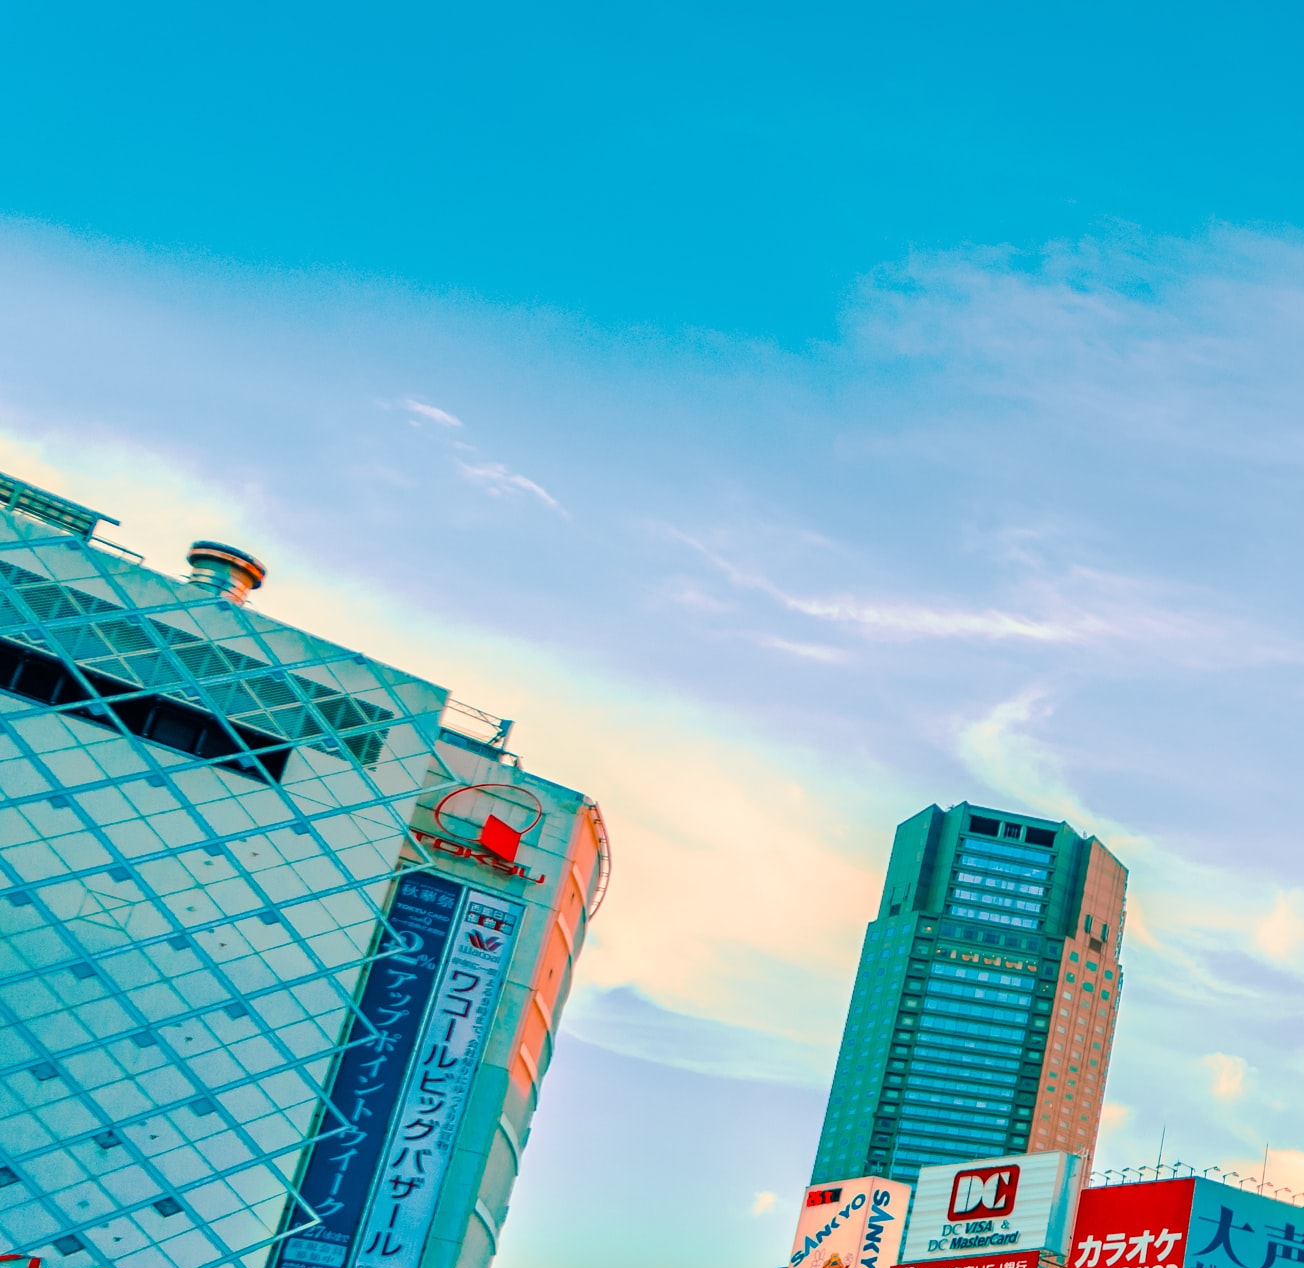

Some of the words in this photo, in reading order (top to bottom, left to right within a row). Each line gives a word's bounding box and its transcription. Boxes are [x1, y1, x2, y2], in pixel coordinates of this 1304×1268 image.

[410, 828, 546, 884] TOKYU
[366, 970, 480, 1256] ワコールビッグバザール
[953, 1171, 1011, 1214] DC
[791, 1194, 866, 1268] SANKYO
[928, 1239, 949, 1252] DC
[950, 1231, 1019, 1249] MasterCard
[942, 1223, 962, 1237] DC
[964, 1220, 993, 1233] VISA
[1074, 1228, 1183, 1268] カラオケ
